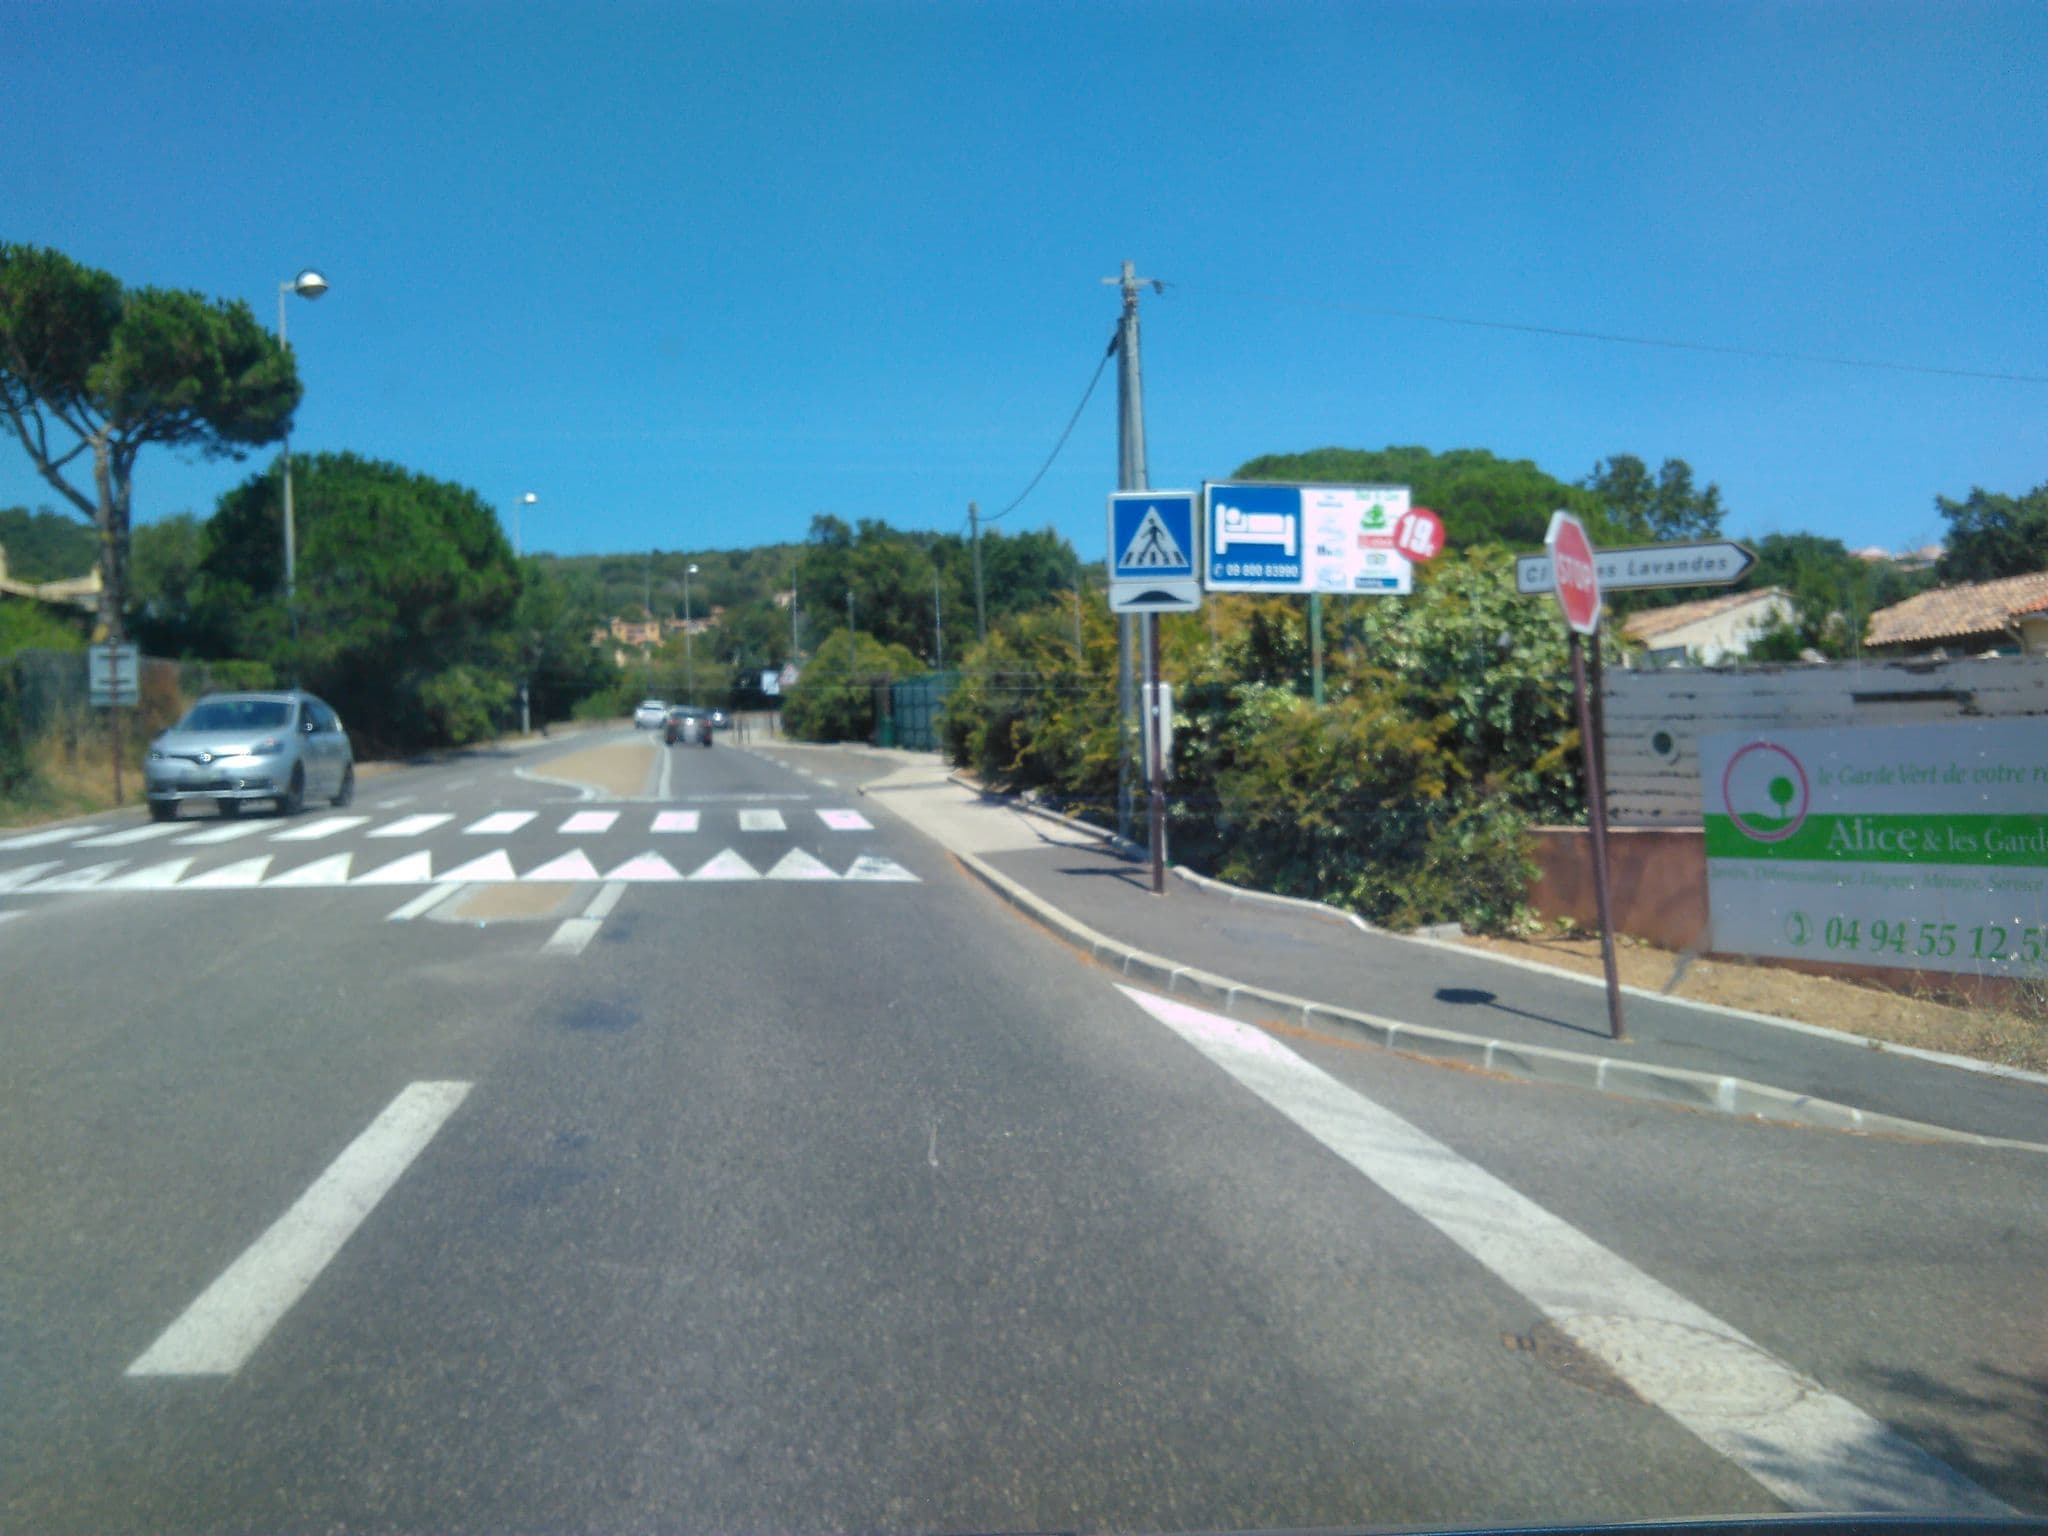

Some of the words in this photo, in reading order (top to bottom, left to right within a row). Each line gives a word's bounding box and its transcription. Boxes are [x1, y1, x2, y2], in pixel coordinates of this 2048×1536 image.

[1556, 553, 1592, 590] STOP
[1627, 555, 1728, 578] Lavandes
[1826, 817, 1922, 851] Alice
[1922, 832, 1941, 852] &
[1946, 829, 1978, 853] les
[1825, 914, 1861, 951] 04
[1869, 919, 1907, 954] 94
[1917, 923, 1958, 958] 55
[1968, 925, 2011, 961] 12
